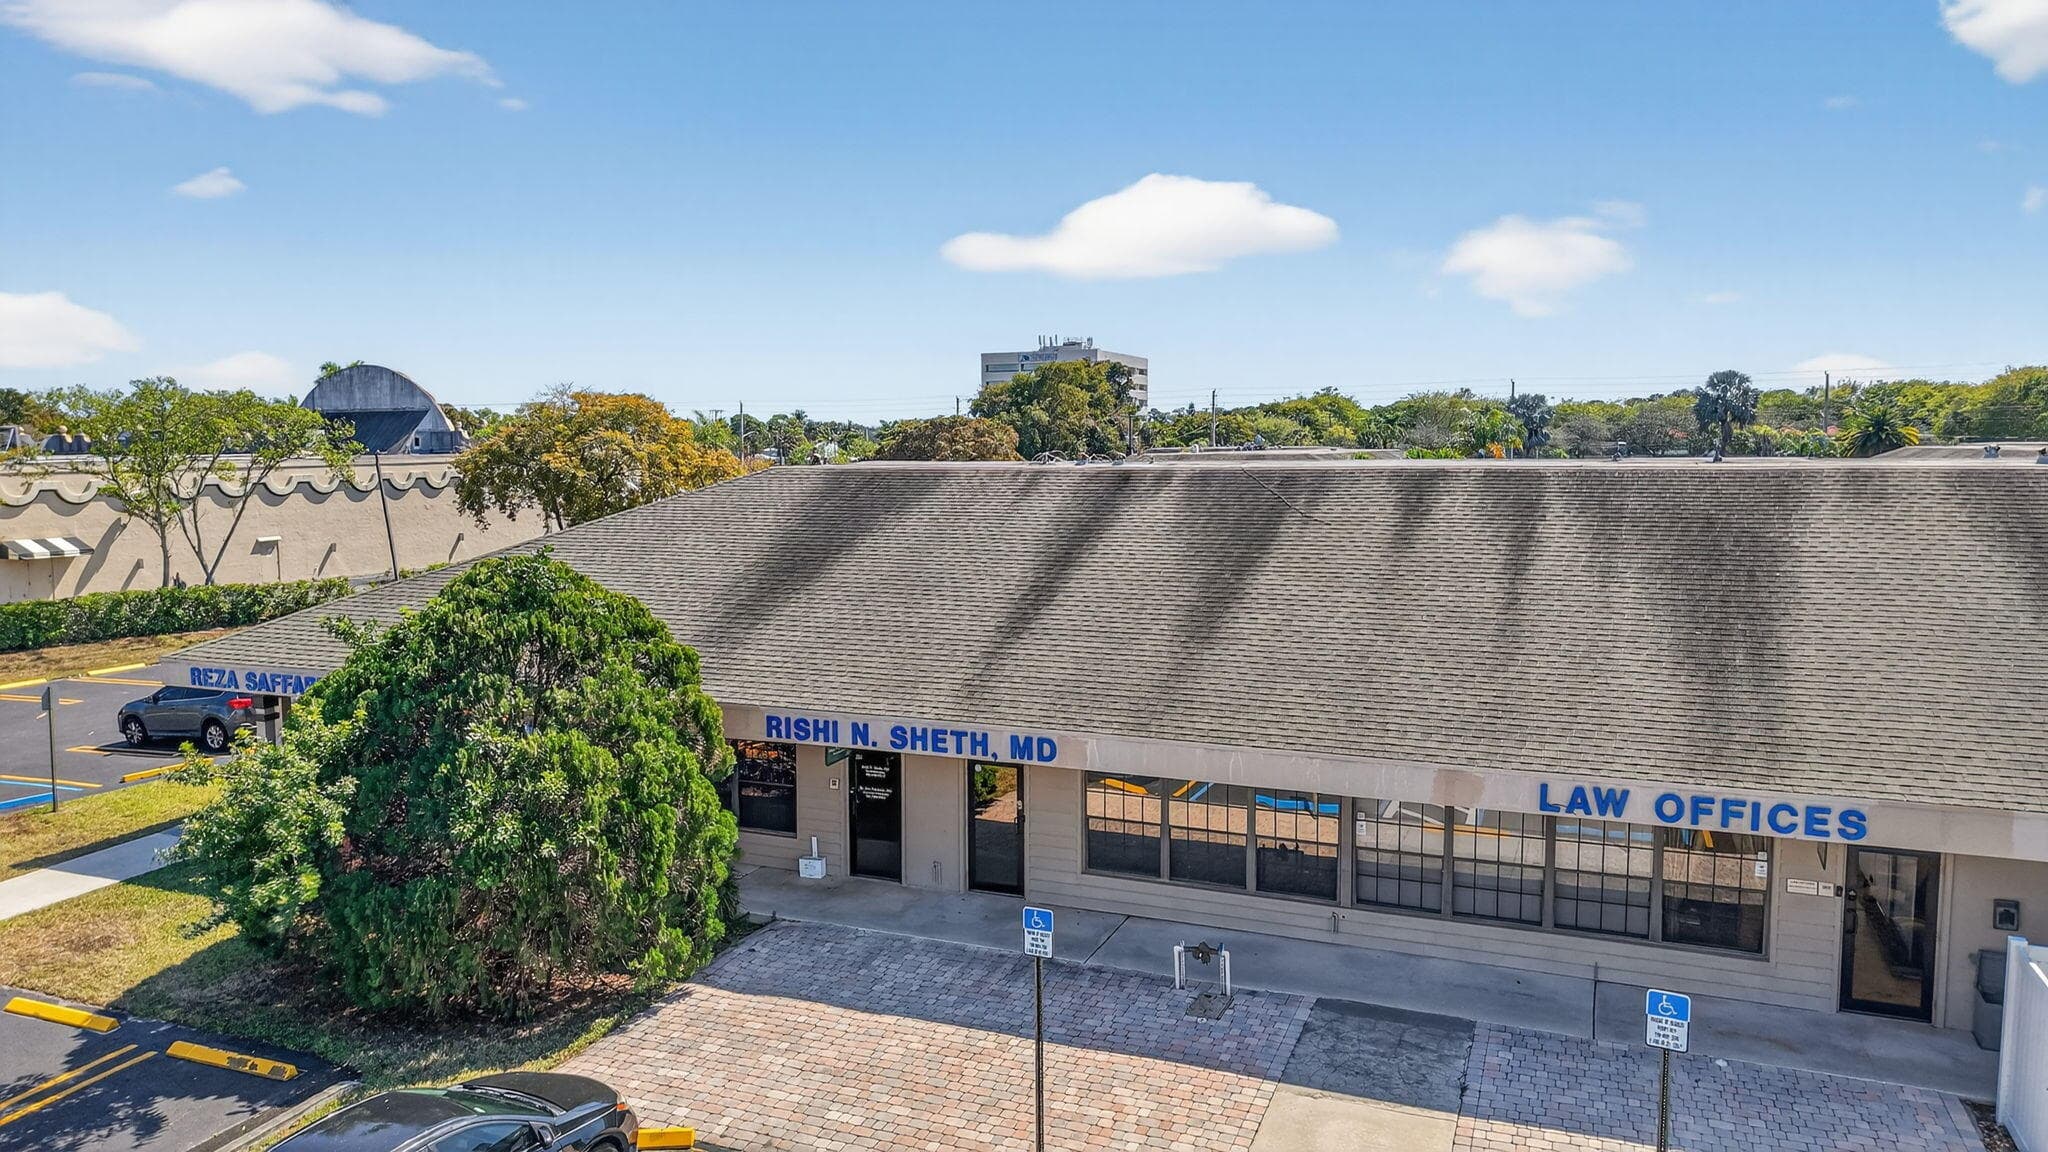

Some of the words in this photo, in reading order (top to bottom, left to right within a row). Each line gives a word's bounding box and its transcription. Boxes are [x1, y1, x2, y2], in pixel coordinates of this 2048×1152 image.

[190, 667, 239, 689] REZA
[766, 715, 838, 743] RISHI
[851, 722, 877, 747] N.
[890, 725, 997, 762] SHETH,
[1010, 734, 1057, 762] MD
[1539, 783, 1630, 818] LAW
[1654, 793, 1867, 841] OFFICES
